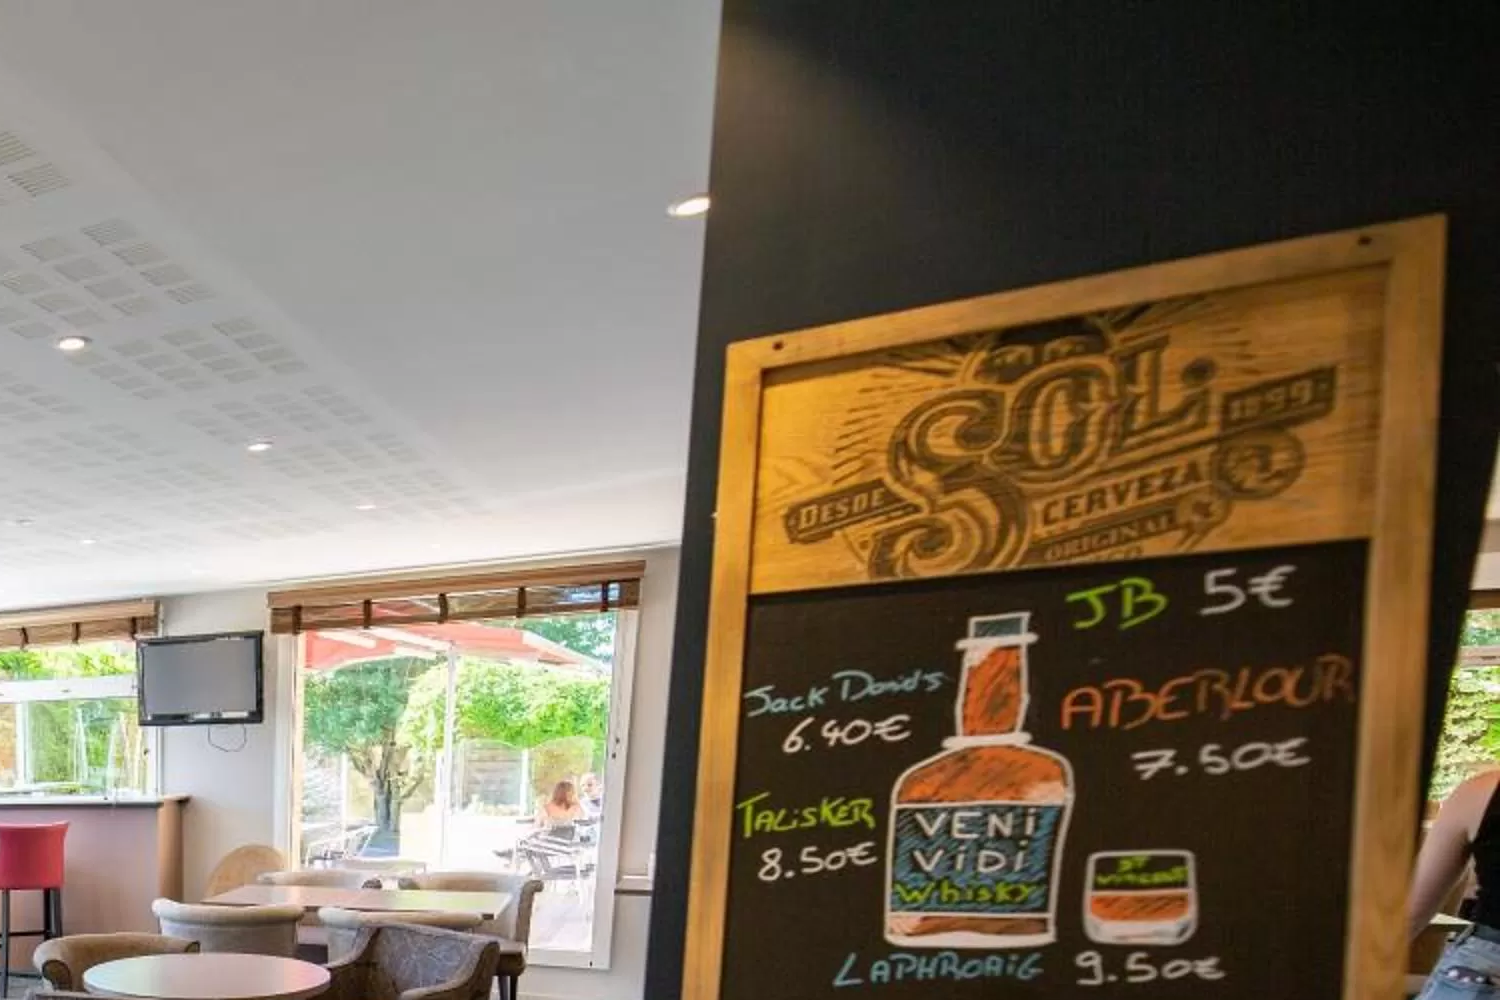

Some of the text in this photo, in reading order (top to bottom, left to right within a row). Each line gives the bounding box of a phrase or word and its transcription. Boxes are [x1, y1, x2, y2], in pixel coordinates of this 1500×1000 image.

[862, 331, 1212, 576] SOL
[797, 486, 887, 530] DESDE
[1041, 457, 1203, 526] CERVEZA
[1065, 563, 1299, 631] JB 5€
[743, 683, 830, 718] Jack
[1060, 652, 1354, 731] ABERLOUR
[781, 713, 913, 755] 6.40€
[1130, 736, 1313, 781] 7.50€
[757, 841, 878, 882] 8.50€
[1074, 950, 1227, 986] 9.50€
